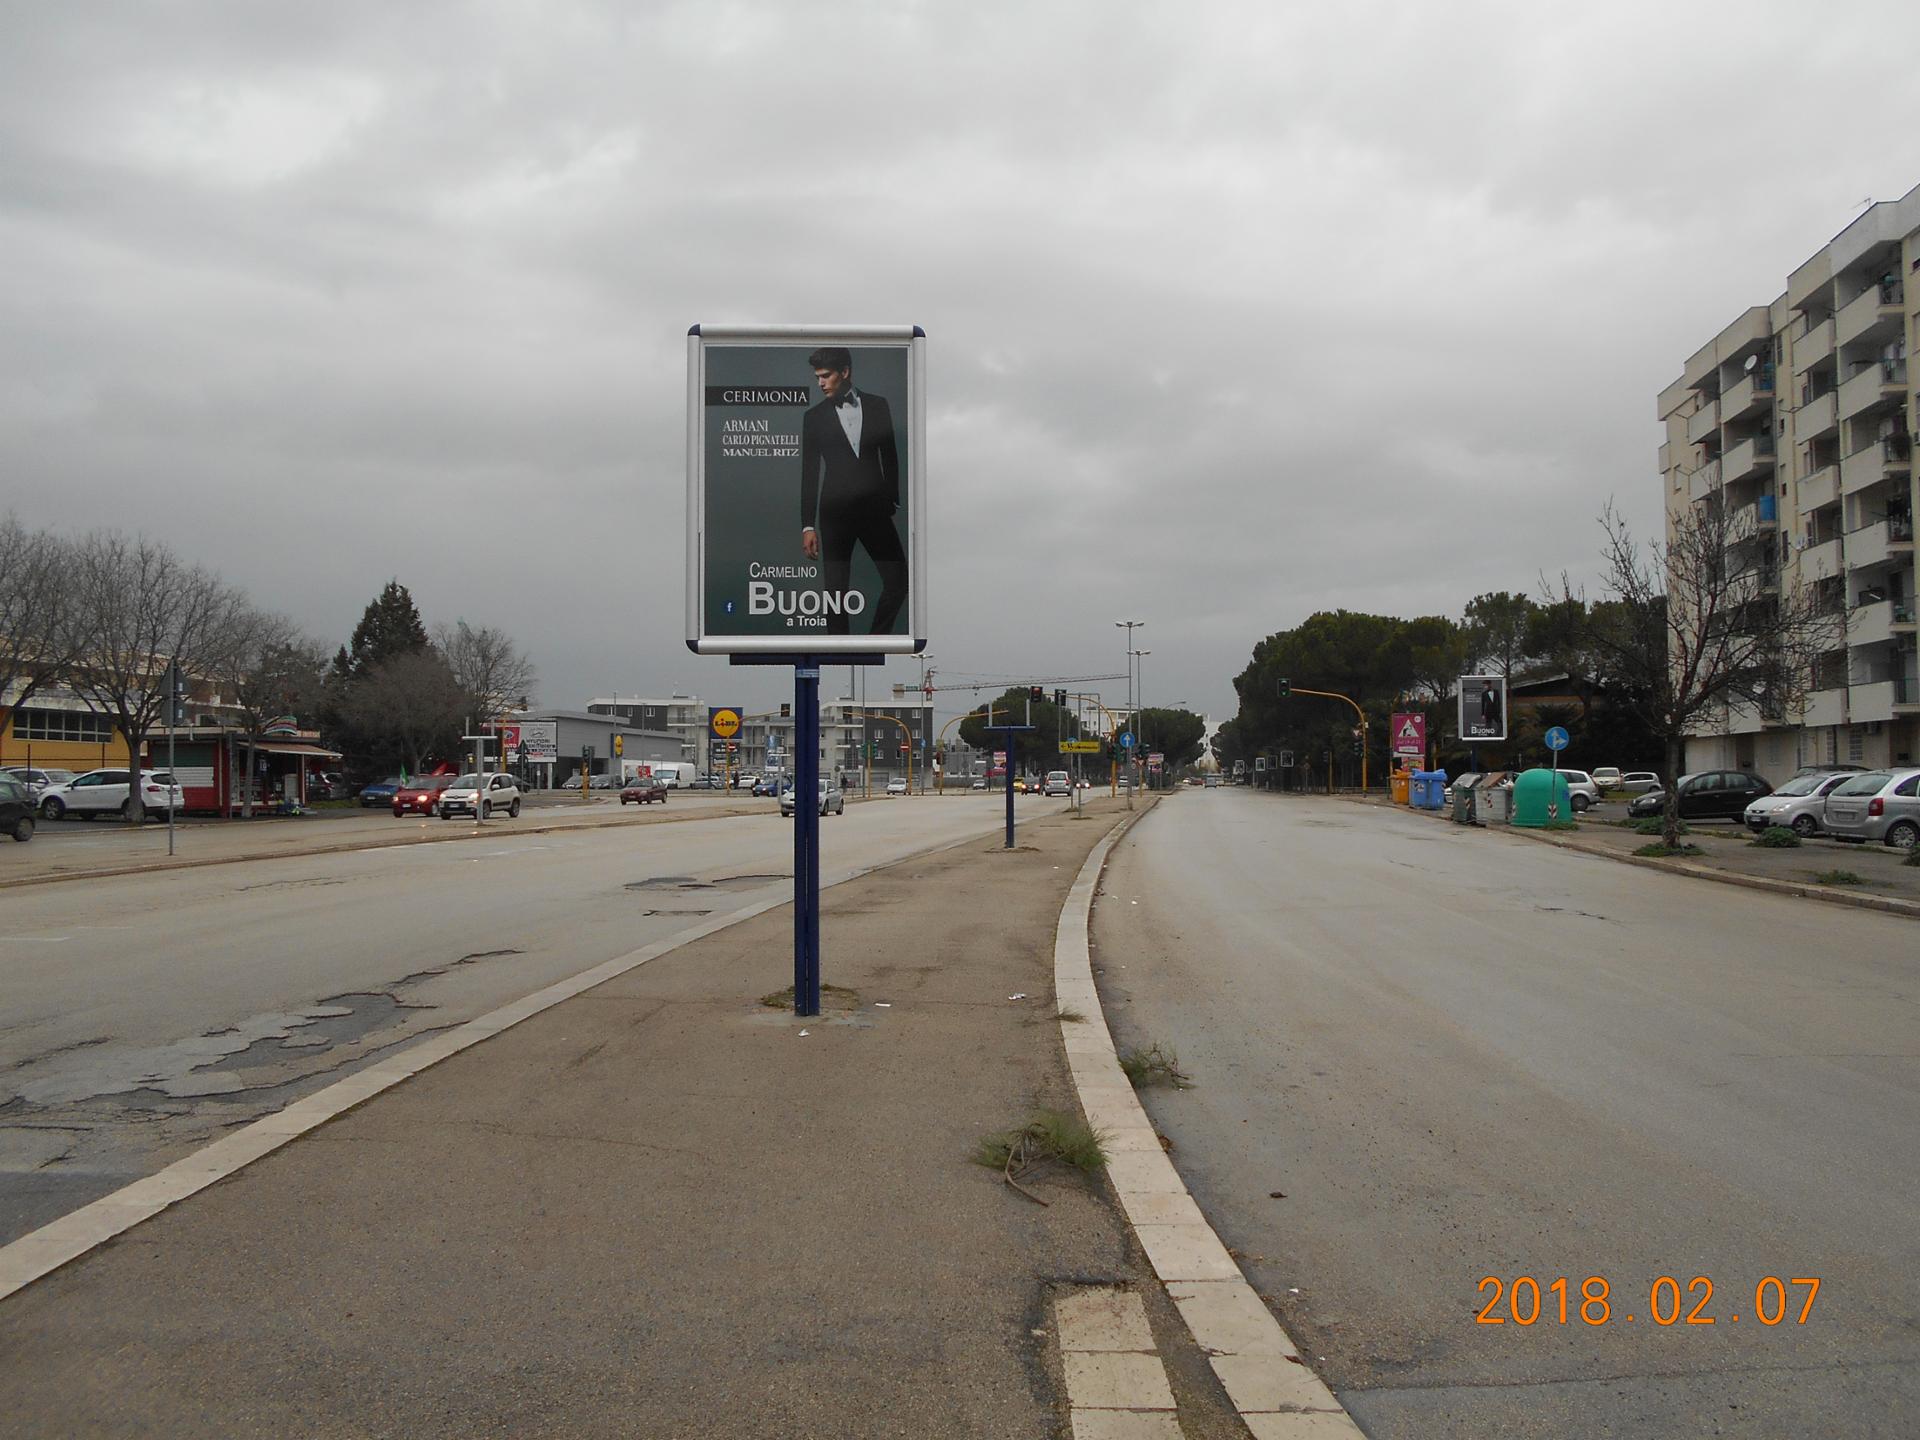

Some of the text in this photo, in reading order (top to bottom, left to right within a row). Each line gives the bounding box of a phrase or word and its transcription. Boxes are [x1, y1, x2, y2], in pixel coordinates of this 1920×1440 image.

[723, 390, 808, 403] CERIMONIA
[722, 419, 769, 432] ARMANI
[722, 434, 800, 446] CARLO PIGNATELLI
[722, 448, 800, 457] MANUEL RITZ
[749, 562, 818, 578] CARMELINO
[748, 581, 866, 615] BUONO
[786, 615, 828, 627] a Troia
